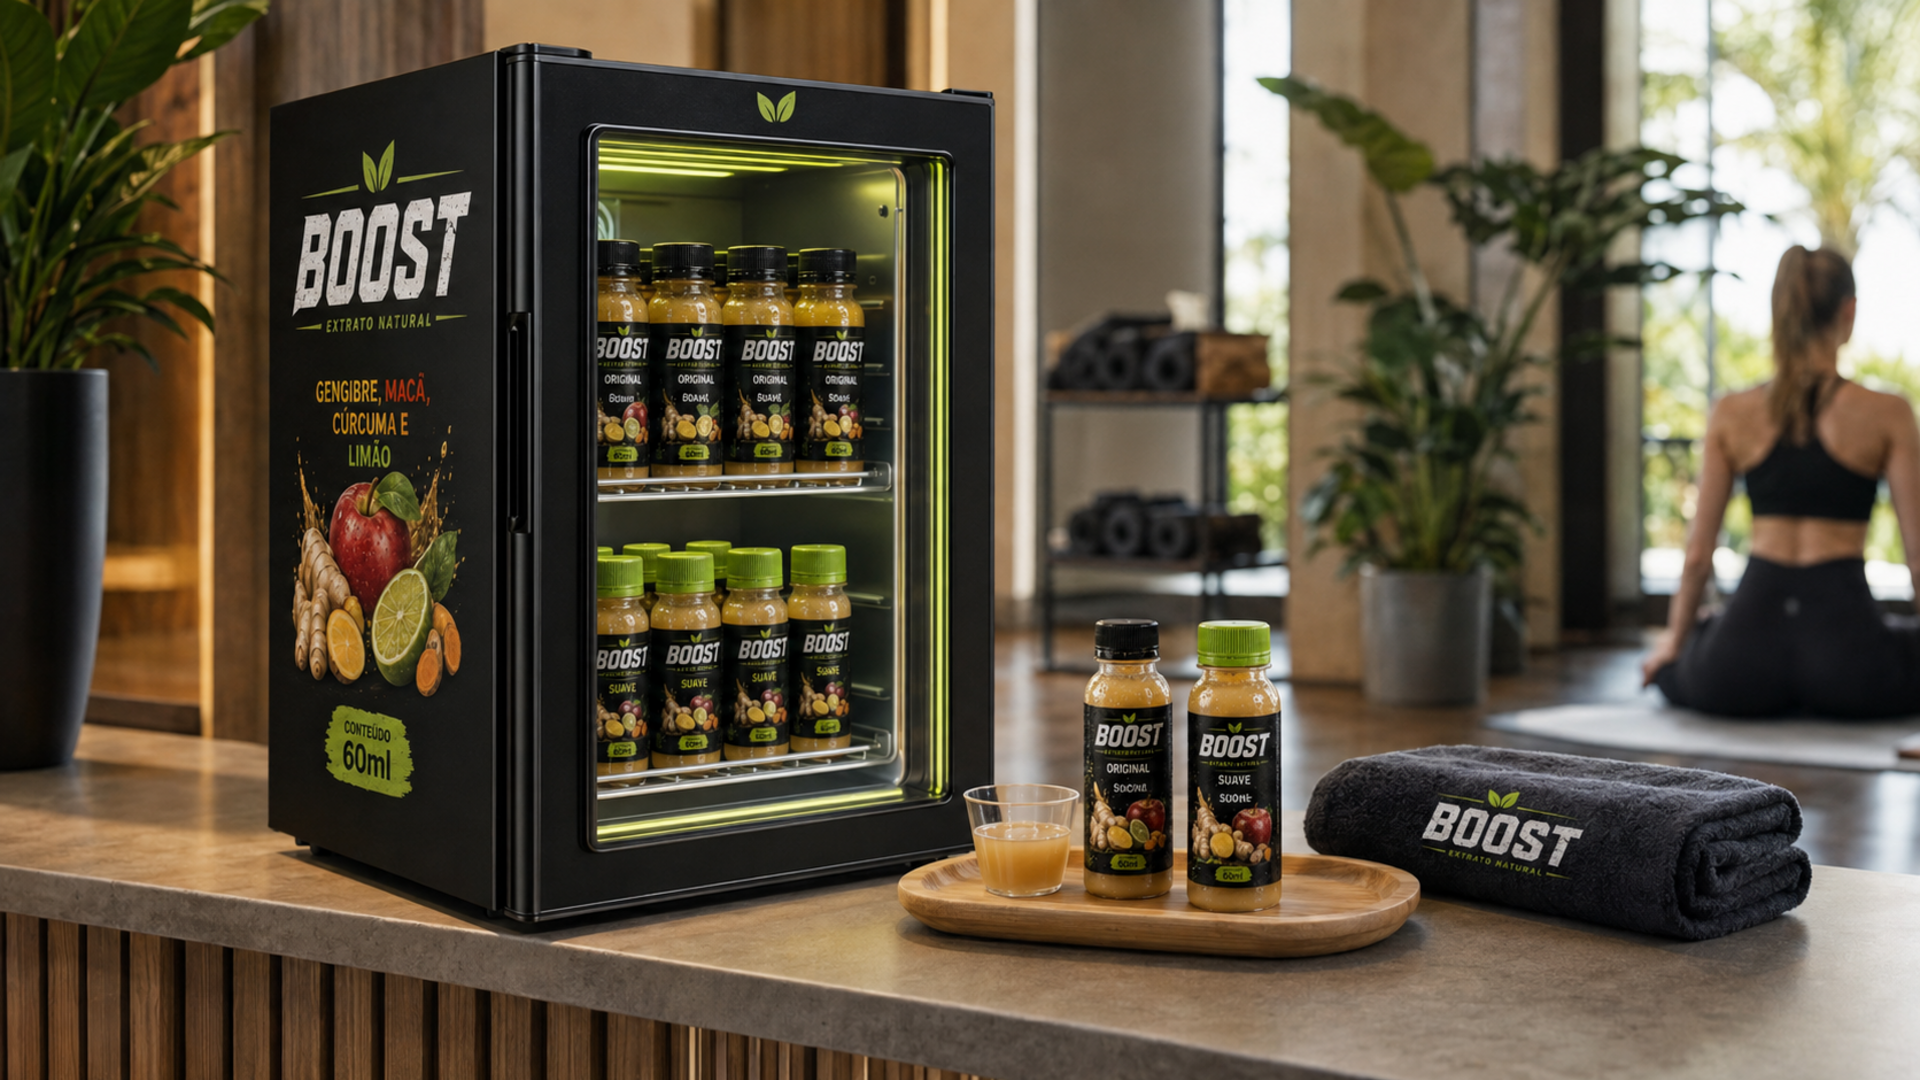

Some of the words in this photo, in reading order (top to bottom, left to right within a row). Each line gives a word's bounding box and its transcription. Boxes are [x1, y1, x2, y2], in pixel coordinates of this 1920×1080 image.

[292, 191, 472, 316] BOOST
[326, 316, 374, 333] EXTRATO
[378, 312, 431, 330] NATURAL
[597, 337, 649, 359] BOOST
[666, 338, 722, 360] BOOST
[741, 340, 795, 361] BOOST
[812, 341, 864, 362] BOOST
[604, 374, 642, 385] ORIGINAL
[678, 374, 715, 385] ORIGINAL
[752, 375, 788, 385] ORIGINAL
[315, 379, 382, 407] GENGIBRE,
[332, 406, 397, 436] CÚRCUMA
[400, 412, 409, 436] E
[348, 439, 391, 468] LIMÃO
[665, 641, 720, 665] BOOST
[738, 636, 788, 659] BOOST
[802, 631, 850, 653] BOOST
[597, 646, 648, 670] BOOST
[752, 671, 777, 682] SUAVE
[609, 682, 637, 694] SUAVE
[344, 720, 391, 743] CONTEÚDO
[1095, 722, 1164, 747] BOOST
[1199, 732, 1270, 758] BOOST
[343, 740, 391, 781] 60ml
[1106, 763, 1150, 774] ORIGINAL
[1218, 774, 1251, 785] SUAVE
[1422, 801, 1584, 868] BOOST
[1448, 849, 1492, 866] EXTRATO
[1495, 860, 1542, 877] NATURAL
